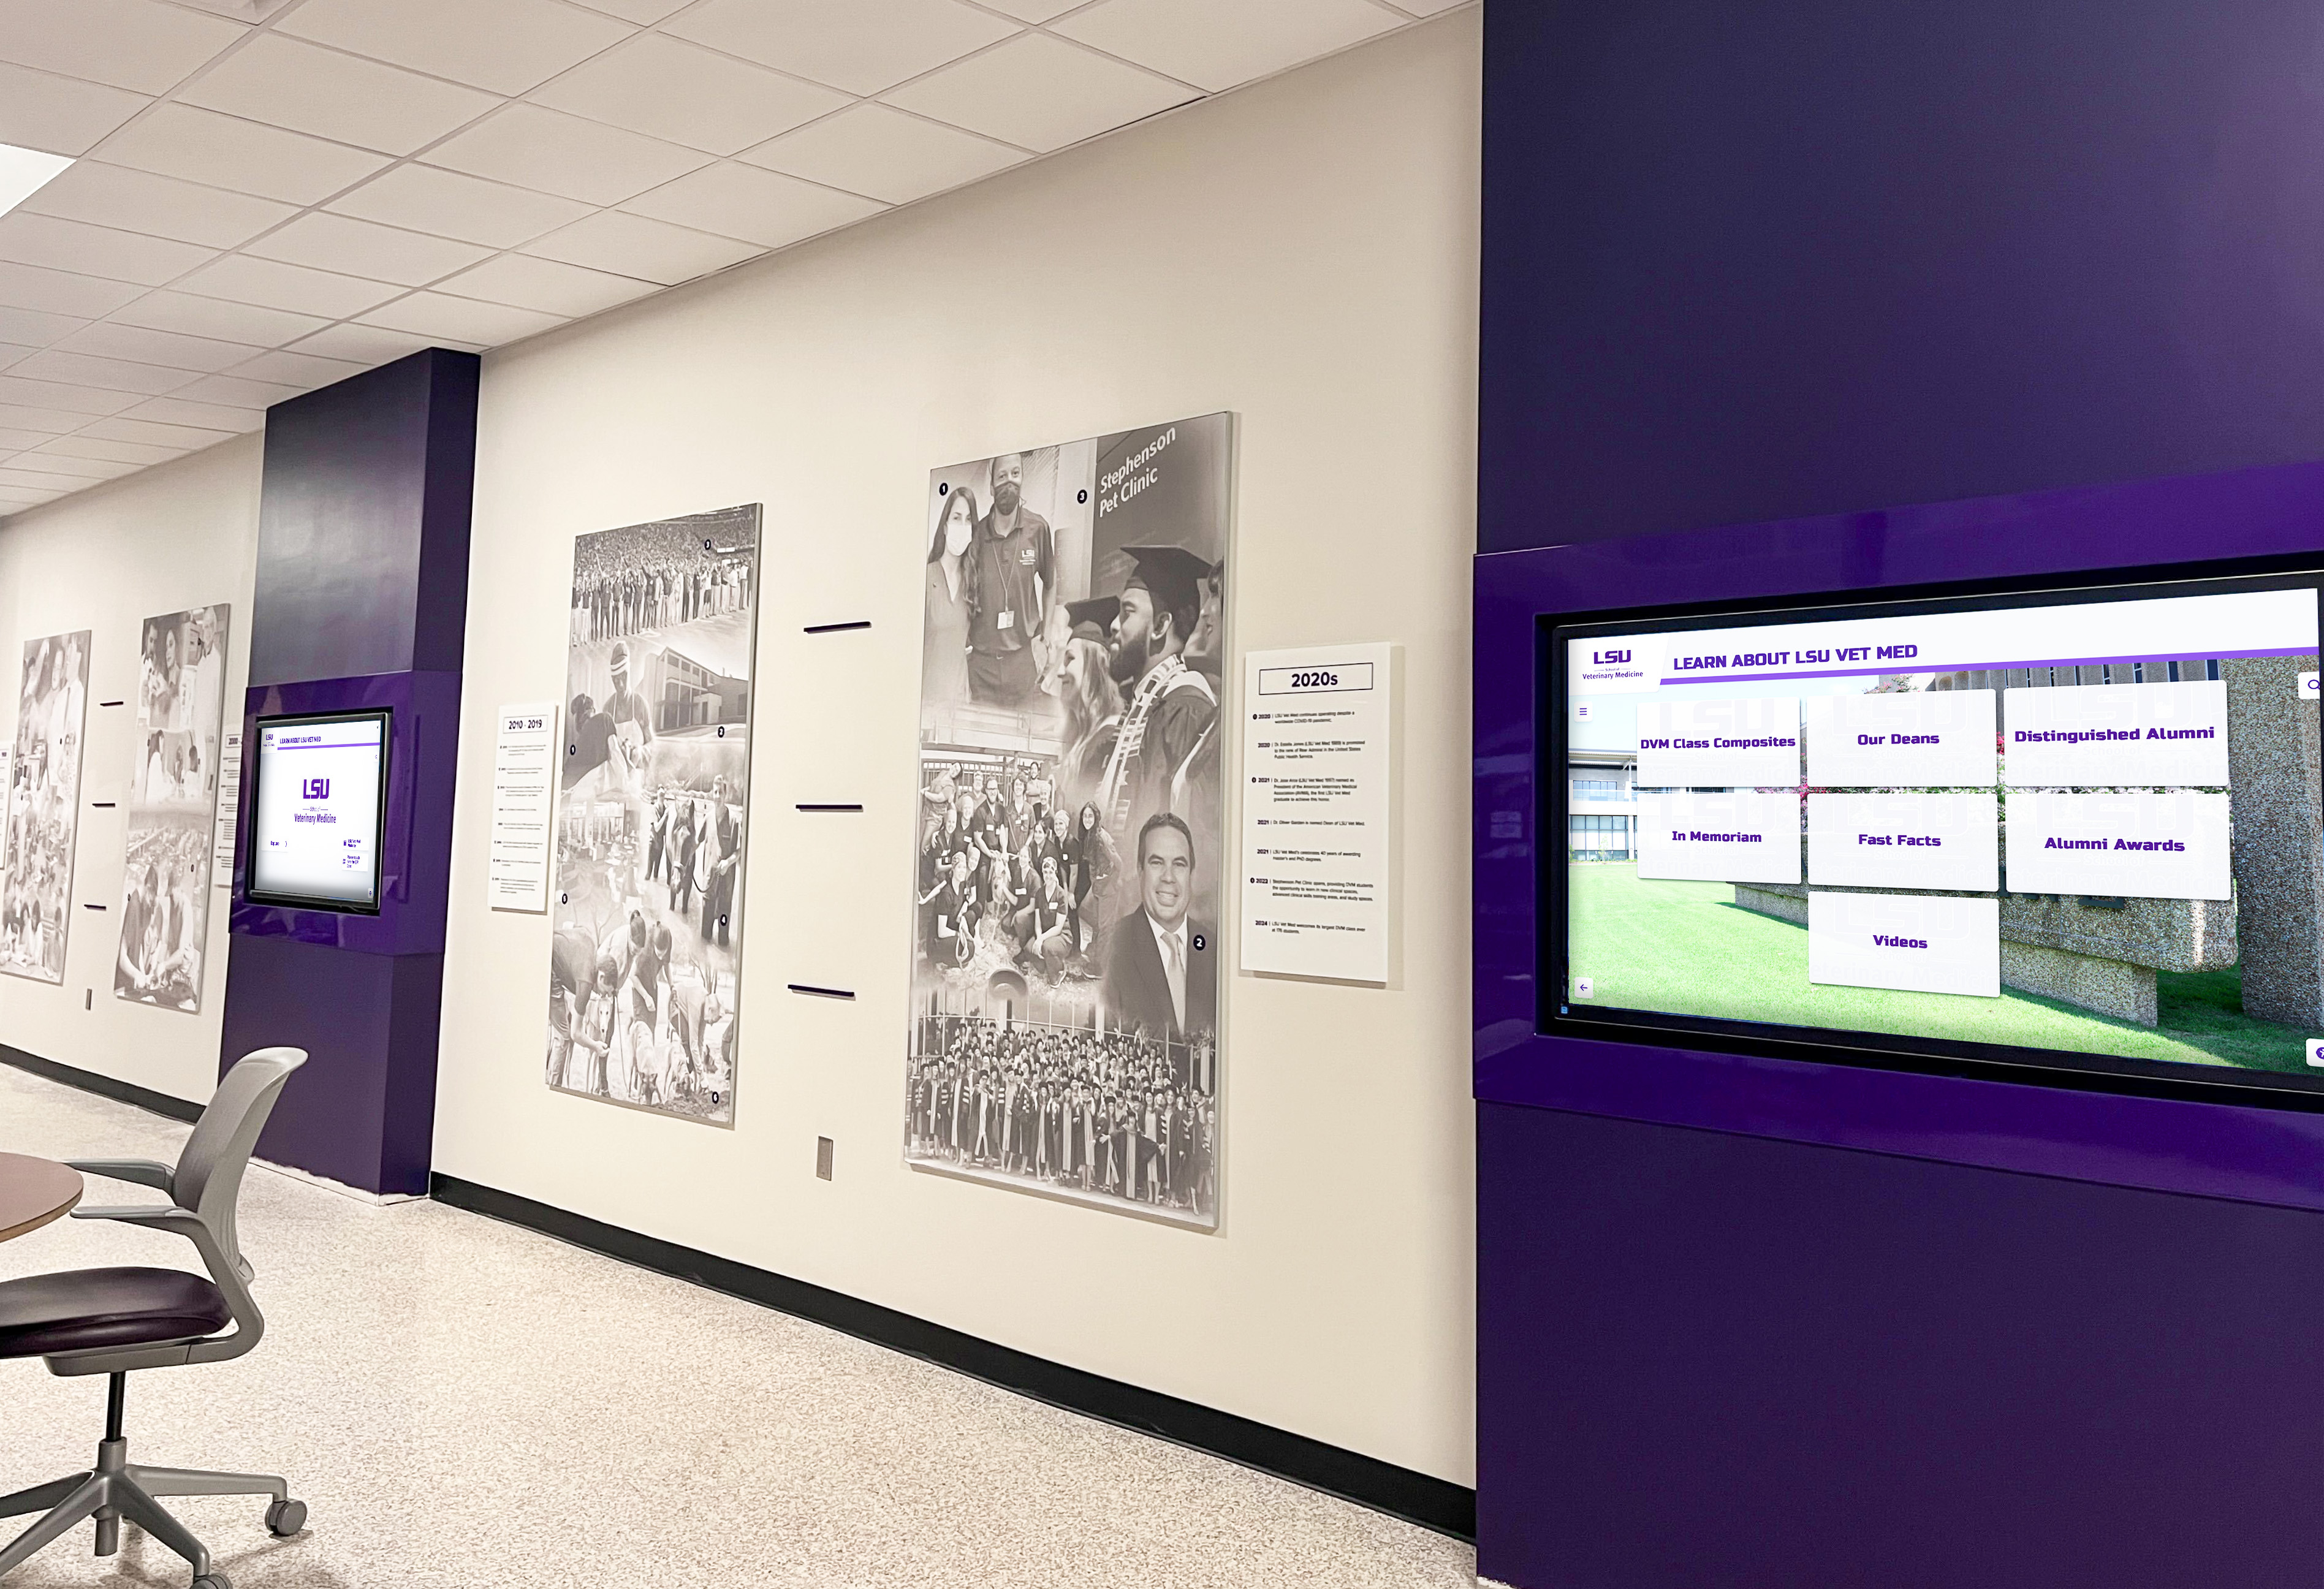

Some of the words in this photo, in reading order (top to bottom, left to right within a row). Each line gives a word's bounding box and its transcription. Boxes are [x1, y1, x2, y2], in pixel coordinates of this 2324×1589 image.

[1101, 427, 1175, 493] Stephenson
[1080, 492, 1085, 501] 3
[1100, 492, 1118, 517] Pet
[1121, 468, 1157, 502] Clinic
[1594, 650, 1631, 664] LSU
[1674, 655, 1726, 670] LEARN
[1731, 652, 1789, 668] ABOUT
[1795, 650, 1830, 664] LSU
[1835, 647, 1871, 662] VET
[1877, 645, 1918, 659] MED
[1292, 672, 1338, 687] 2020s
[509, 720, 523, 729] 2010
[528, 719, 542, 728] 2019
[1858, 734, 1885, 745] Our
[1891, 734, 1940, 745] Deans
[2015, 728, 2140, 743] Distinguished
[2146, 727, 2214, 740] Alumni
[1641, 739, 1669, 749] DVM
[1674, 738, 1709, 748] Class
[1714, 737, 1796, 749] Composites
[1639, 765, 1720, 783] eterinary
[1725, 764, 1800, 781] Medicin
[1809, 763, 1903, 783] eterinary
[1910, 761, 1996, 781] Medicin
[2007, 760, 2118, 784] eterinary
[2126, 759, 2227, 780] Medicin
[303, 779, 329, 799] LSU
[295, 813, 316, 825] Veterinary
[316, 814, 336, 823] Medicine
[1672, 831, 1686, 841] In
[1690, 832, 1761, 842] Memoriam
[1859, 834, 1893, 846] Fast
[1897, 835, 1941, 846] Facts
[2044, 837, 2108, 850] Alumni
[2113, 838, 2185, 852] Awards
[1639, 857, 1719, 877] eterinary
[1726, 859, 1801, 878] Medicin
[1810, 862, 1905, 885] eterinary
[1910, 863, 1997, 886] Medicin
[2008, 868, 2119, 893] eterinary
[2127, 871, 2229, 894] Medicin
[1196, 938, 1202, 947] 2
[1873, 935, 1928, 949] Videos
[1810, 961, 1905, 987] eterinary
[1912, 966, 1999, 992] Medicin
